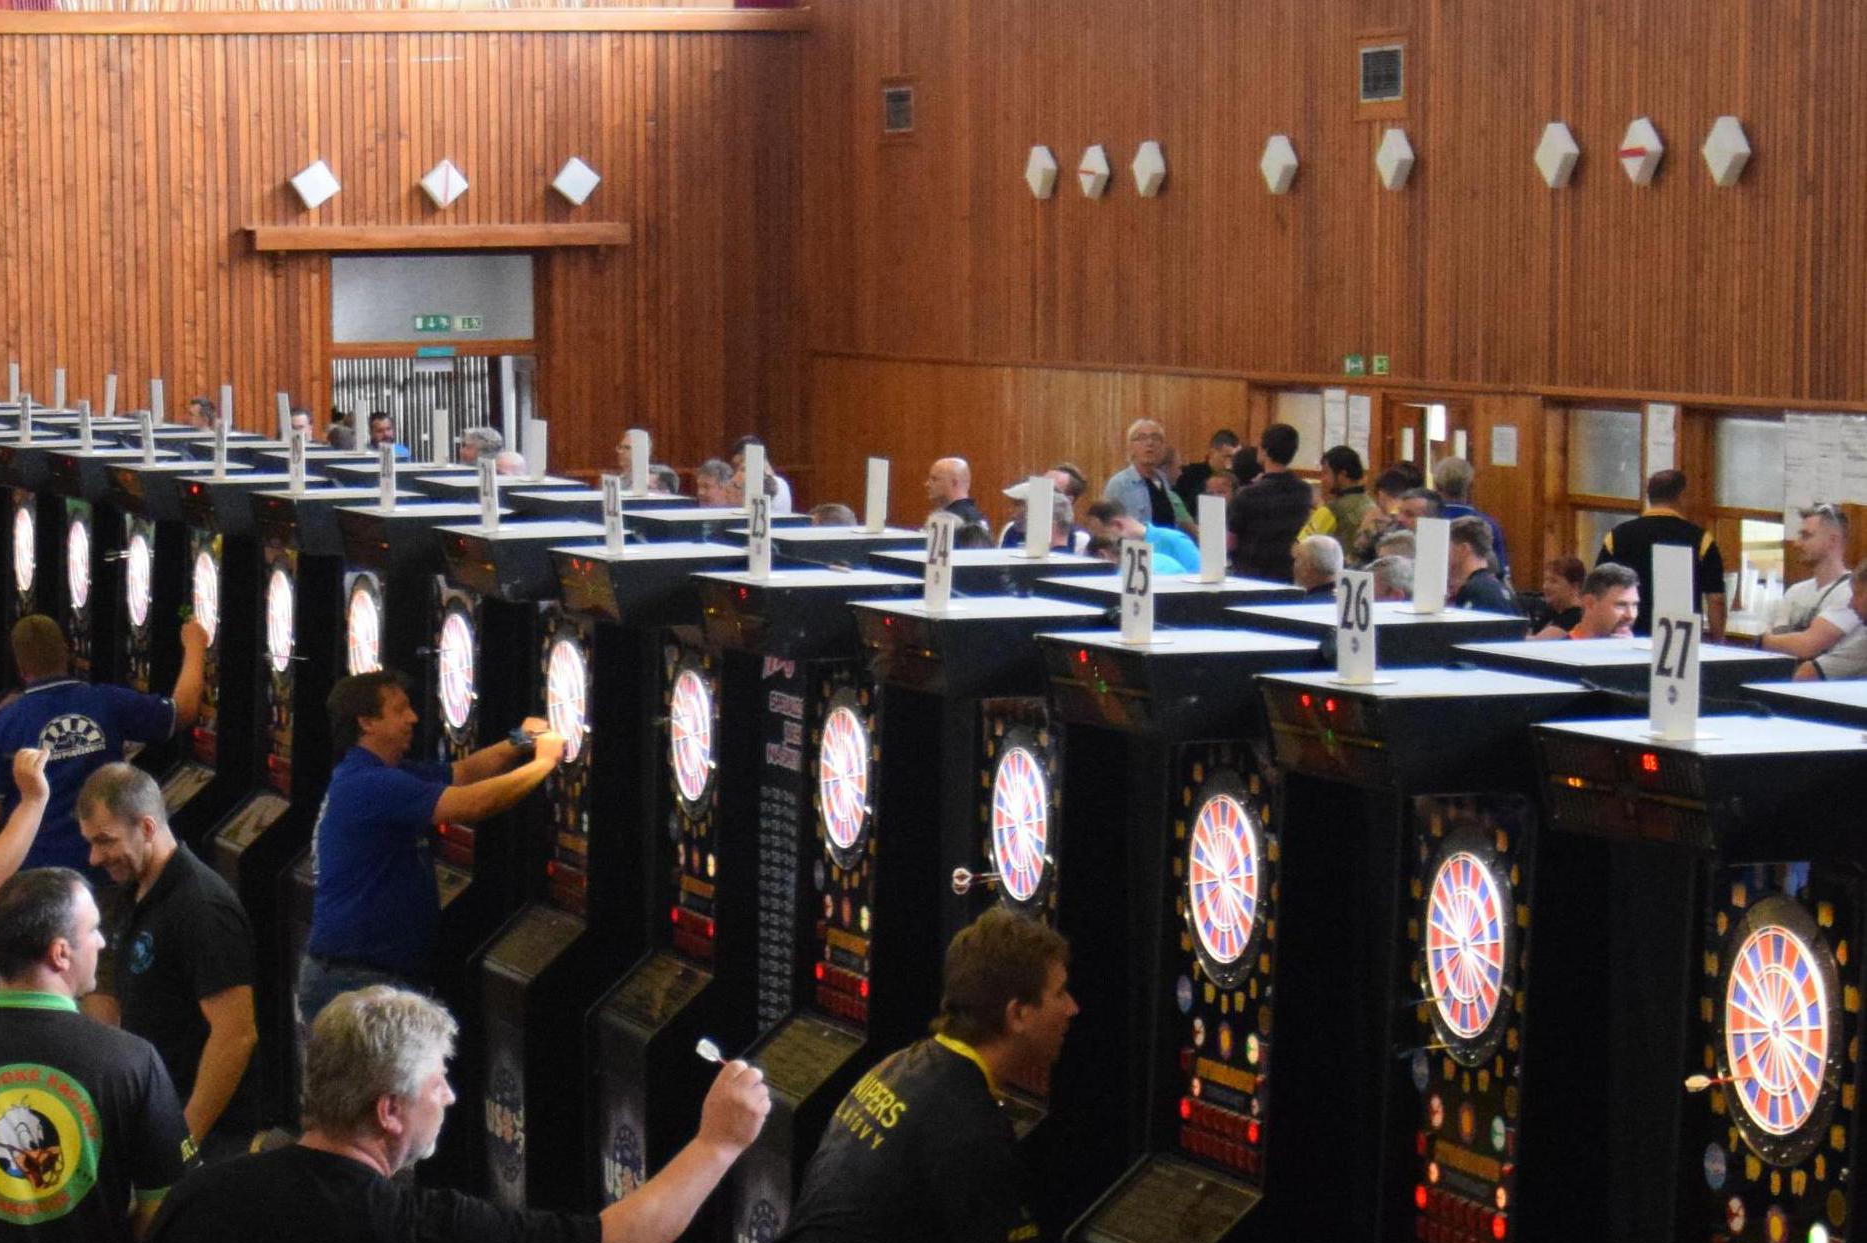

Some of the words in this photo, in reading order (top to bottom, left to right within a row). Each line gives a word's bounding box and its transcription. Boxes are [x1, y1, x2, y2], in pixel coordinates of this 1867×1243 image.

[929, 520, 949, 567] 24
[1125, 547, 1150, 597] 25
[1341, 576, 1371, 632] 26
[1655, 616, 1695, 680] 27
